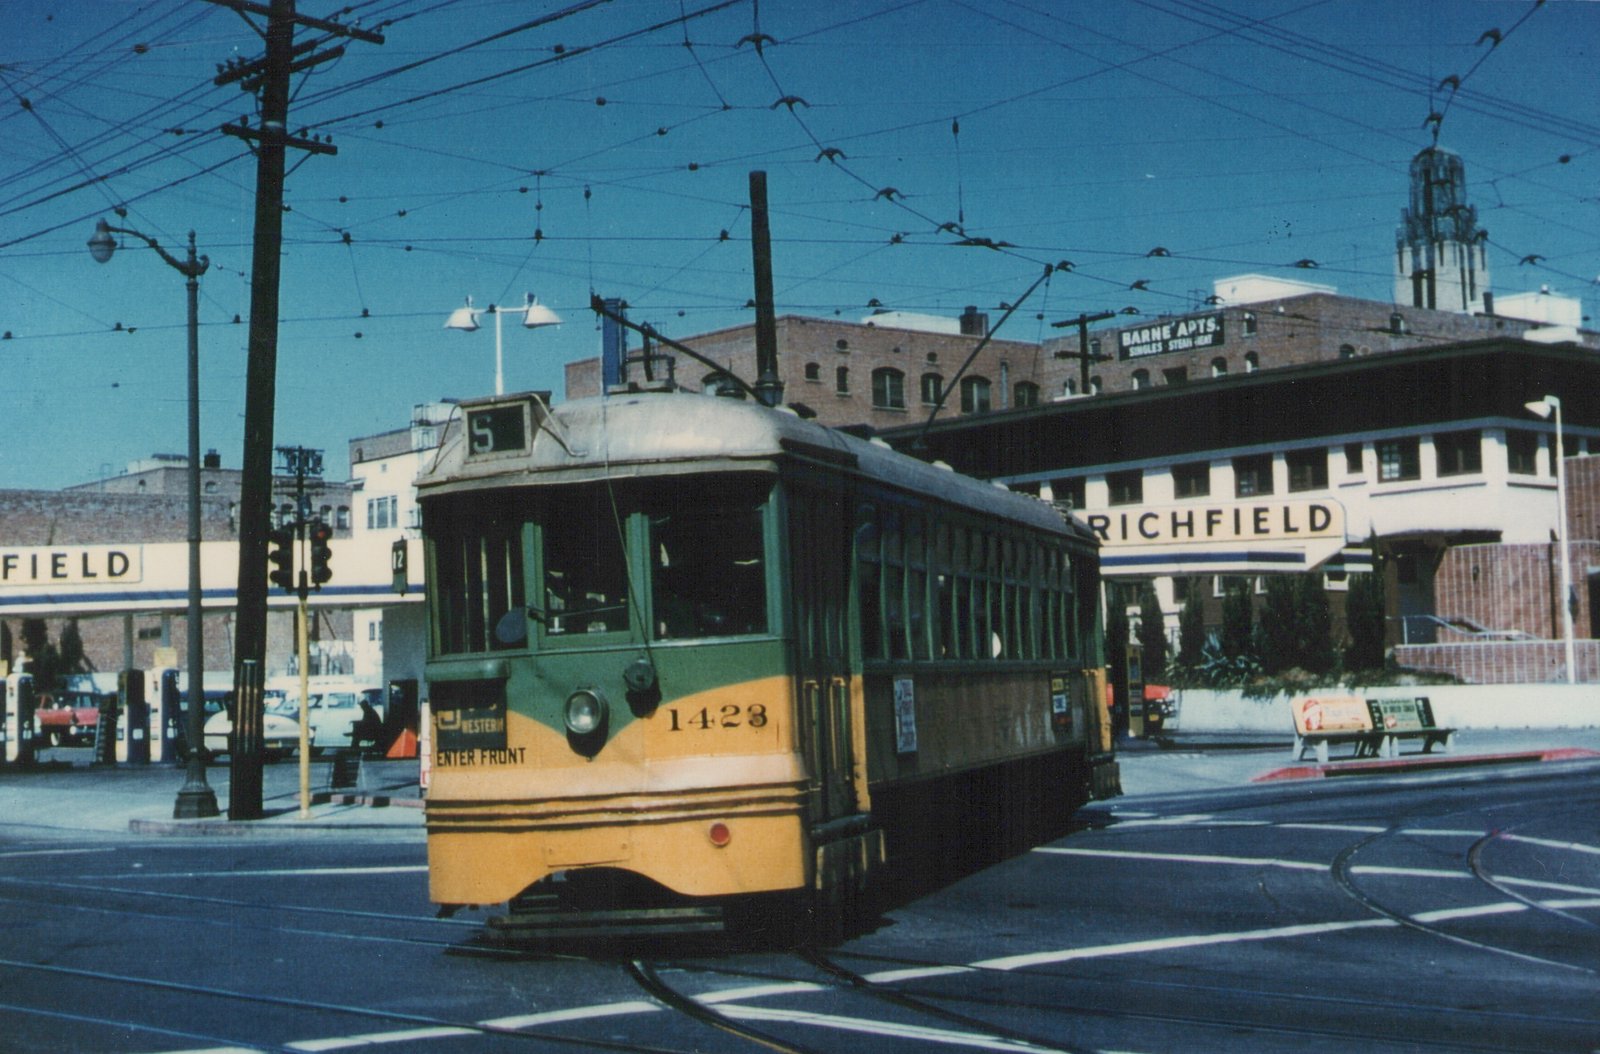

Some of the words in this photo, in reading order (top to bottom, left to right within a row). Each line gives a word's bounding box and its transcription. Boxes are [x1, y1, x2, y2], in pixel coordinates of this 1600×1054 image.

[1177, 317, 1220, 337] APTS.
[1087, 504, 1332, 541] RICHFIELD
[2, 551, 130, 580] FIELD
[393, 550, 403, 570] 12
[437, 750, 475, 767] ENTER
[480, 747, 526, 765] FRONT
